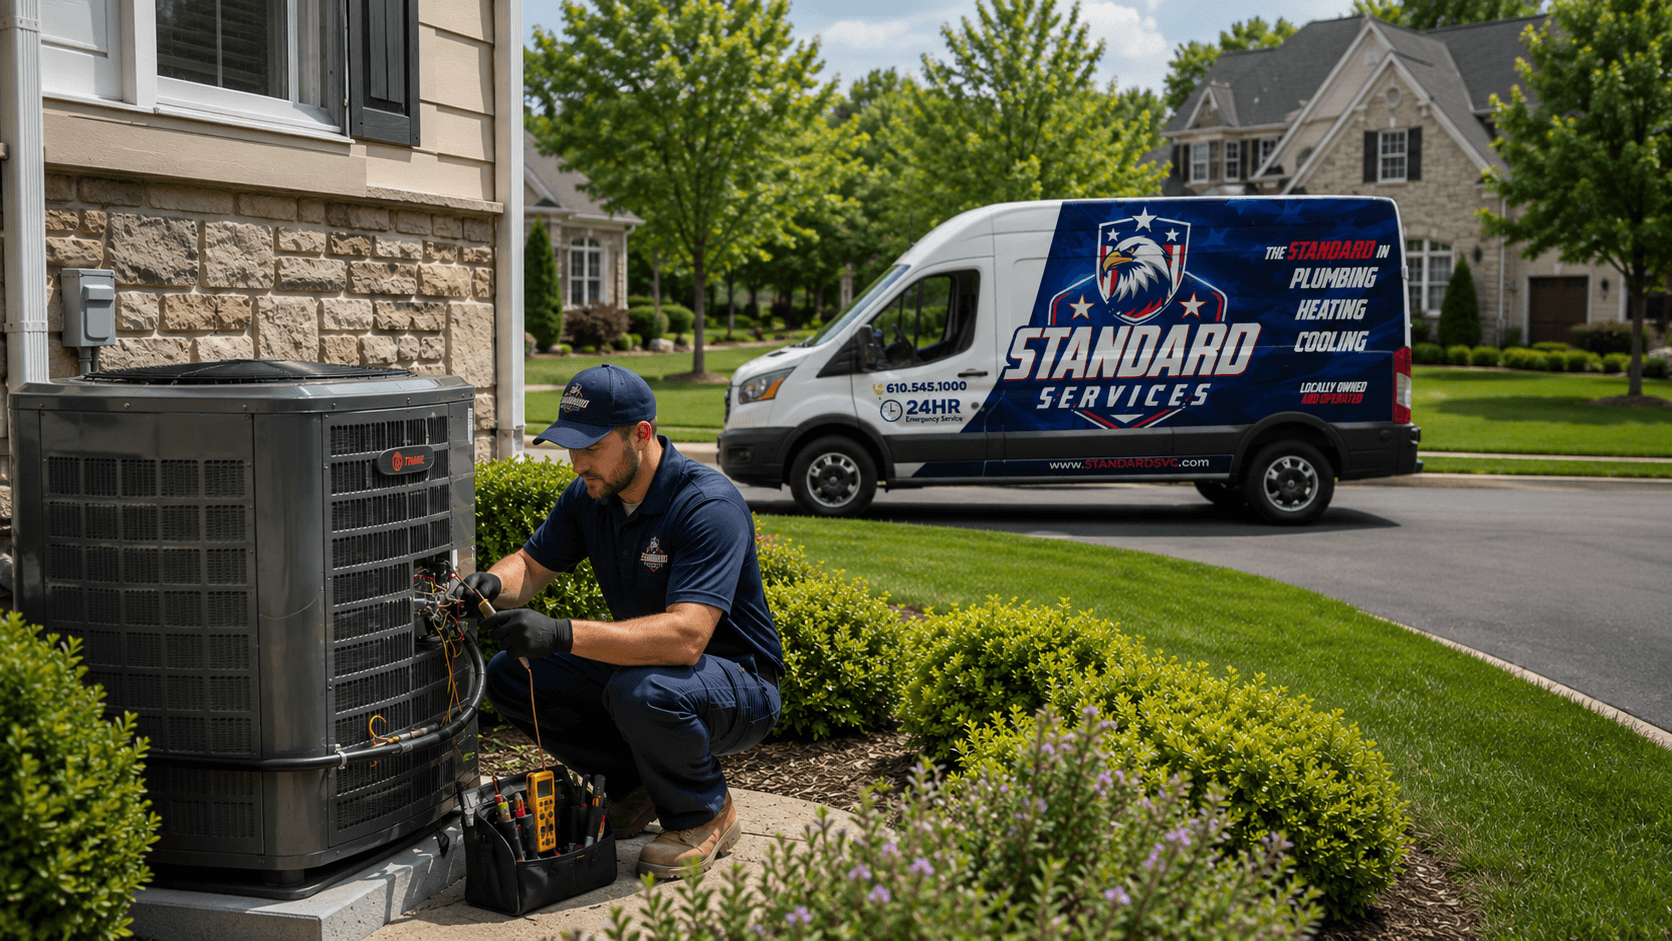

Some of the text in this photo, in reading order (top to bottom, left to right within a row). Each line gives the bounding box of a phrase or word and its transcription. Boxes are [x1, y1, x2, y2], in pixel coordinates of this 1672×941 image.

[1265, 240, 1390, 260] THE STANDARD IN
[1289, 267, 1379, 289] PLUMBING
[1295, 299, 1368, 320] HEATING
[1003, 322, 1262, 381] STANDARD
[1294, 331, 1370, 352] COOLING
[886, 381, 967, 393] 610.545.1000
[1036, 383, 1211, 410] SERVICES
[1300, 381, 1368, 393] LOCALLY OWNED
[906, 399, 961, 415] 24HR
[1049, 458, 1210, 470] www.STANDARDSVC.com
